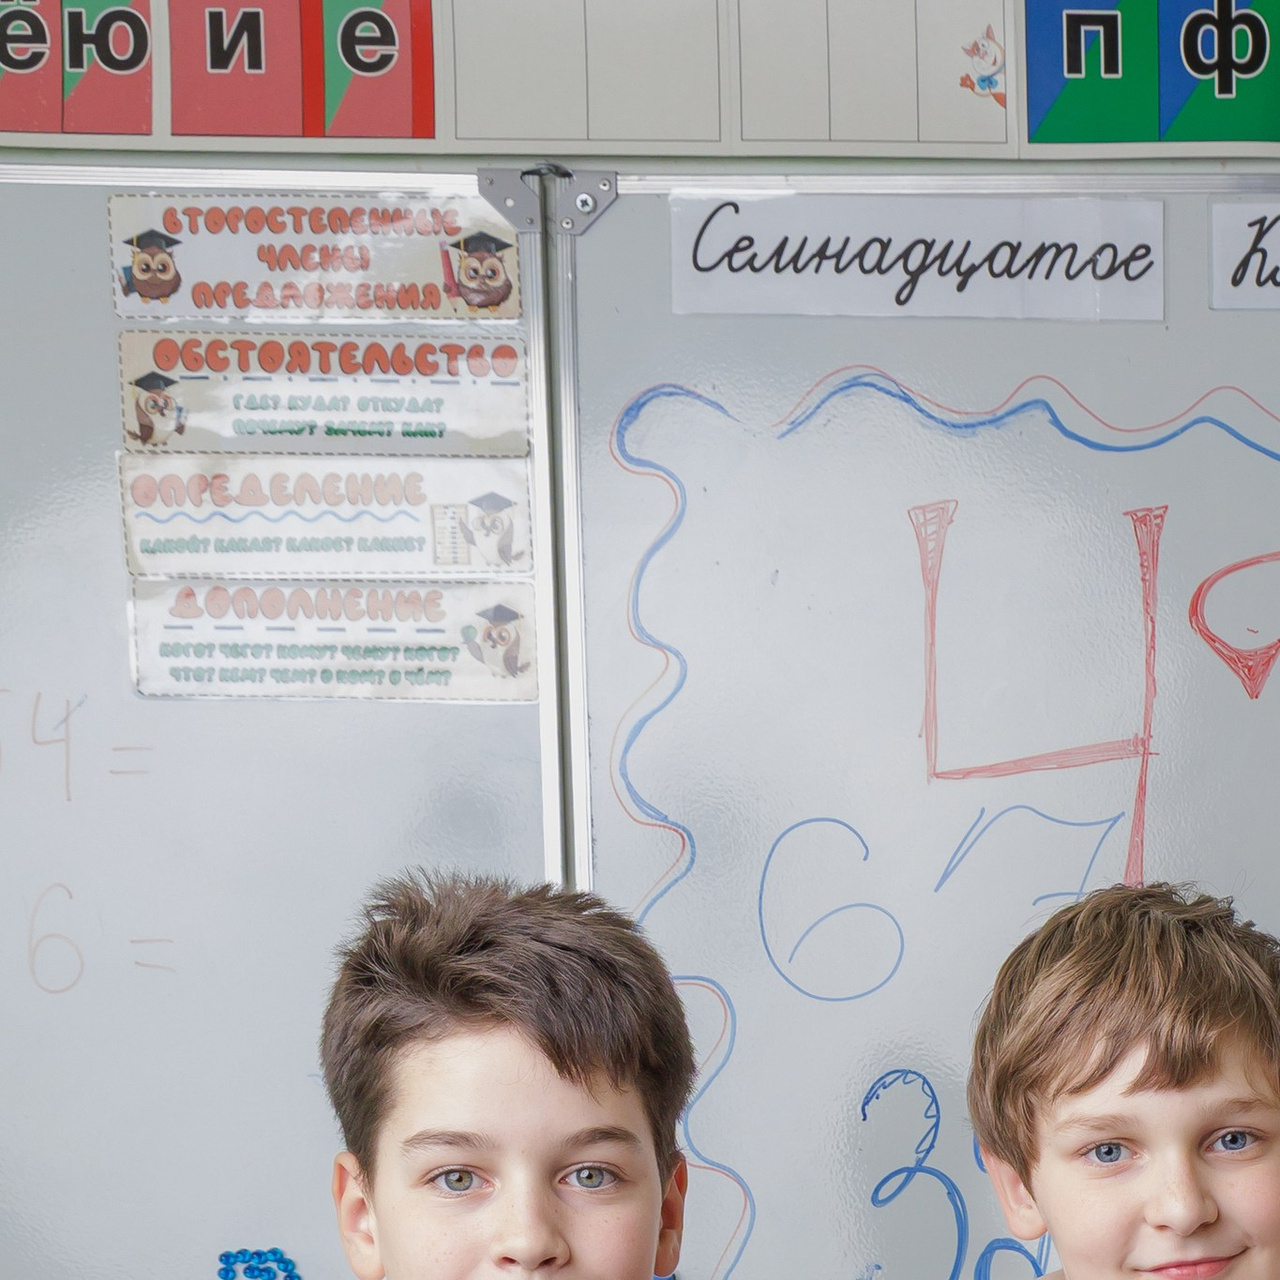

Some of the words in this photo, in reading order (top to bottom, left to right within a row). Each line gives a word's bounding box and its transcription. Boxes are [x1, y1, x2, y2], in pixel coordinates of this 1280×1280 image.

[163, 206, 462, 236] ВТОРОСТЕПЕННЫЕ
[257, 243, 371, 272] ЧЛЕНЫ
[692, 202, 1155, 306] Семнадцатое
[192, 280, 441, 310] ПРЕДЛОЖЕНИЯ
[153, 338, 518, 377] ОБСТОЯТЕЛЬСТВО
[131, 472, 427, 508] ОПРЕДЕЛЕНИЕ
[168, 586, 447, 623] ДОПОЛНЕНИЕ
[759, 804, 1126, 1002] 67
